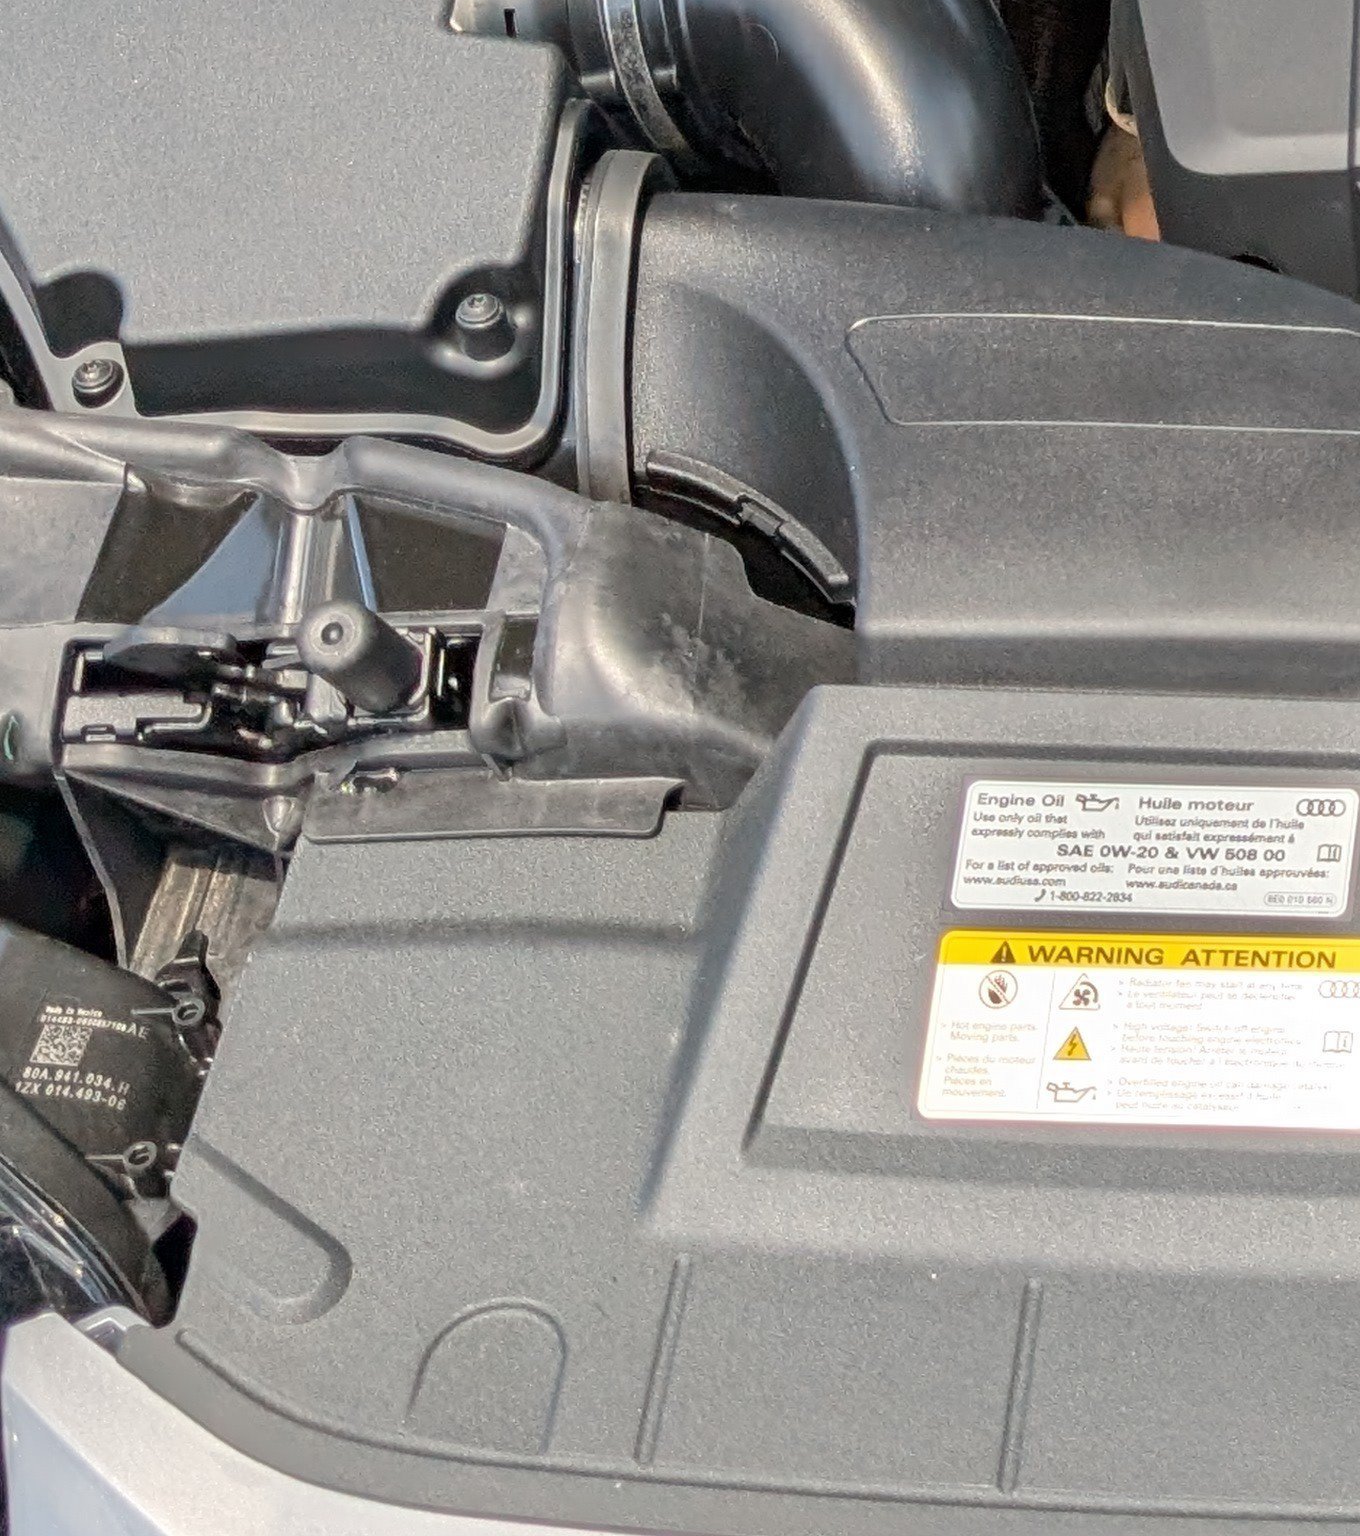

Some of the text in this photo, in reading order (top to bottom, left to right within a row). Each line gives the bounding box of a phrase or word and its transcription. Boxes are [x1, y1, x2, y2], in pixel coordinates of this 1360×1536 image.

[977, 792, 1065, 809] Engine Oil
[1138, 796, 1255, 812] Huile moteur
[973, 814, 1068, 827] Use only oil that
[1135, 816, 1305, 830] Utilisez uniquement de l'huile
[971, 829, 1105, 840] expressly complies with
[1133, 832, 1152, 843] qui
[1155, 832, 1201, 843] satisfait
[1203, 833, 1285, 845] expressément
[1056, 844, 1286, 861] SAE 0W-20 & VW 508 00
[965, 859, 1114, 874] For a list of approved oils:
[1128, 864, 1330, 880] Pour une liste d'huiles approuvées:
[963, 875, 1066, 887] www.audiusa.com
[1125, 878, 1238, 891] www.audicanada.ca
[1049, 890, 1133, 903] 1-800-822-2834
[1028, 945, 1337, 970] WARNING ATTENTION
[951, 1022, 969, 1030] Hot
[972, 1023, 1007, 1033] engine
[950, 1031, 989, 1044] Moving
[982, 1054, 996, 1064] du
[999, 1056, 1036, 1064] moteur
[979, 1078, 992, 1086] en
